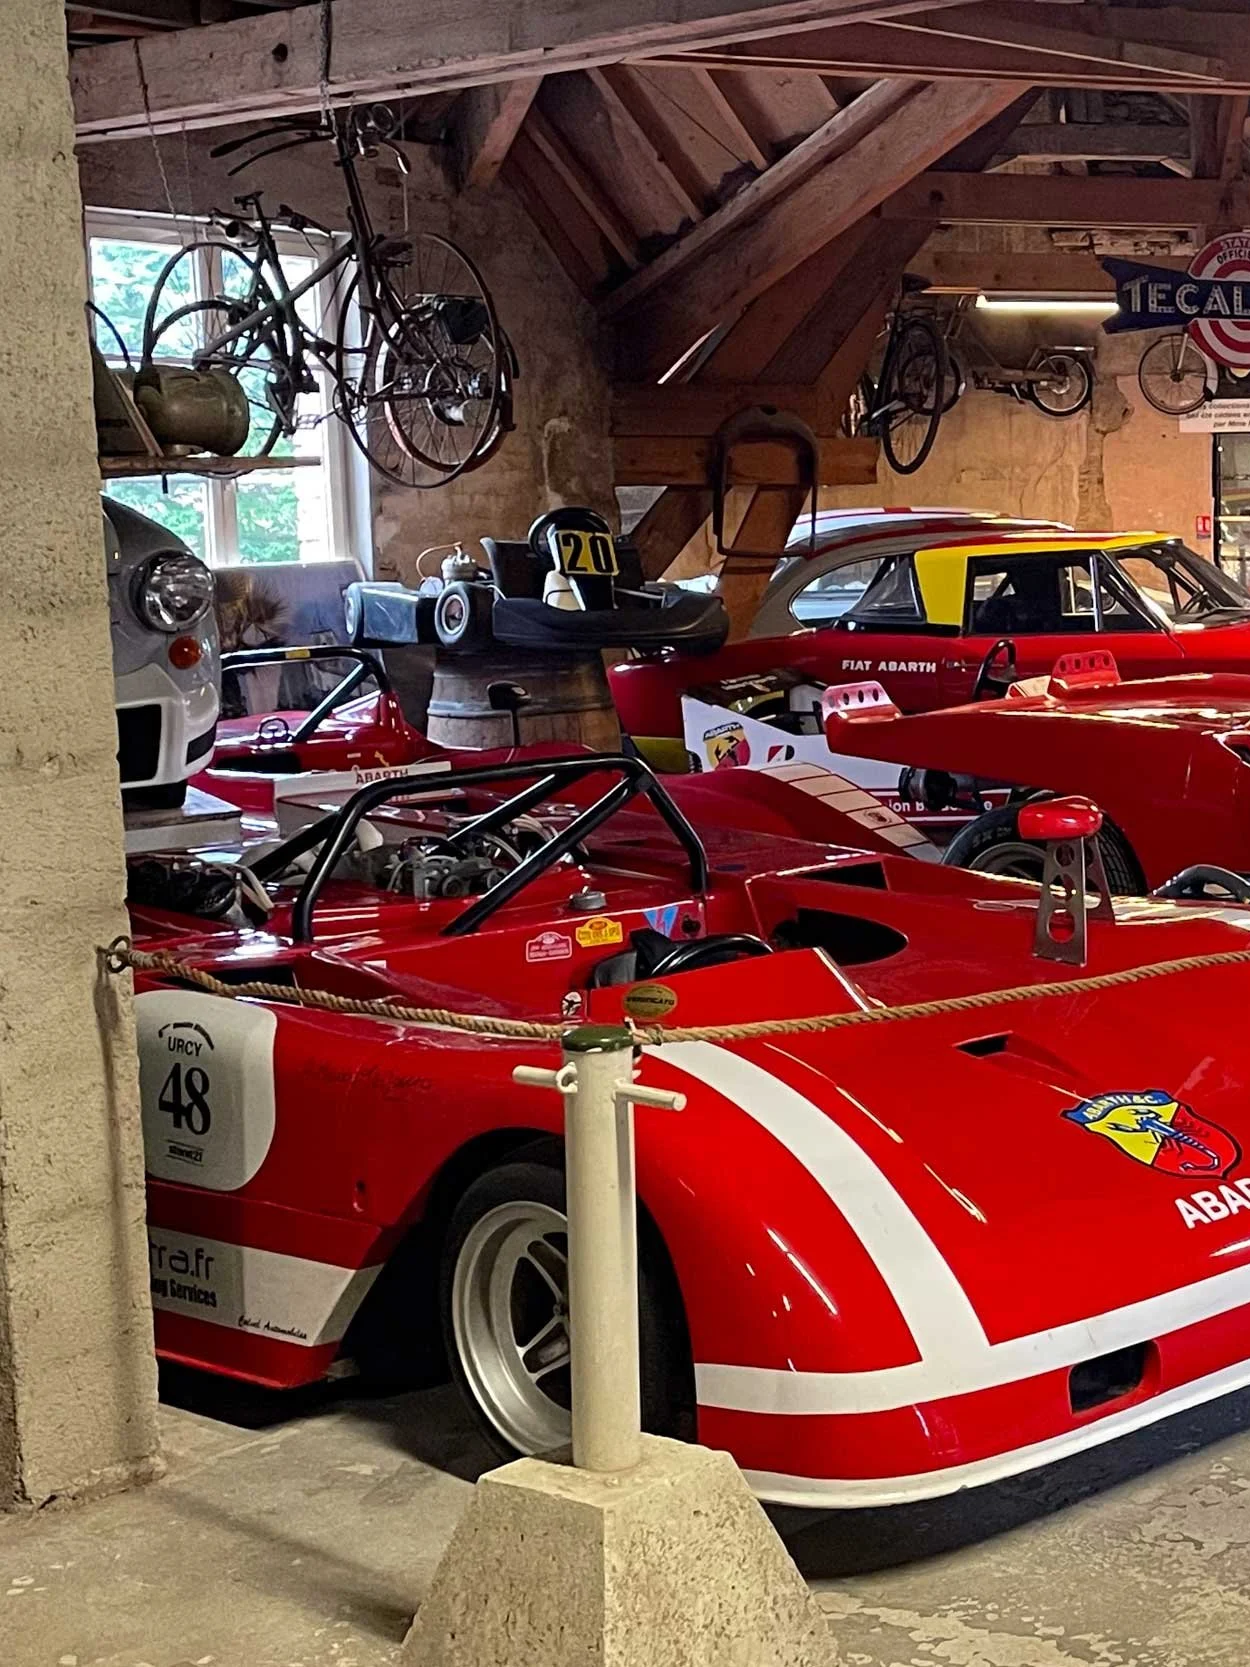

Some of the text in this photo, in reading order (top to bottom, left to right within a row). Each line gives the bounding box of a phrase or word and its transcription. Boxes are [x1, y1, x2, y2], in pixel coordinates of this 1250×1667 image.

[561, 532, 615, 573] 20
[841, 659, 937, 673] FIAT ABARTH
[355, 767, 409, 786] ABARTH
[167, 1035, 203, 1057] URCY
[157, 1062, 212, 1136] 48
[1083, 1094, 1132, 1120] ABARTH
[169, 1278, 218, 1308] Services
